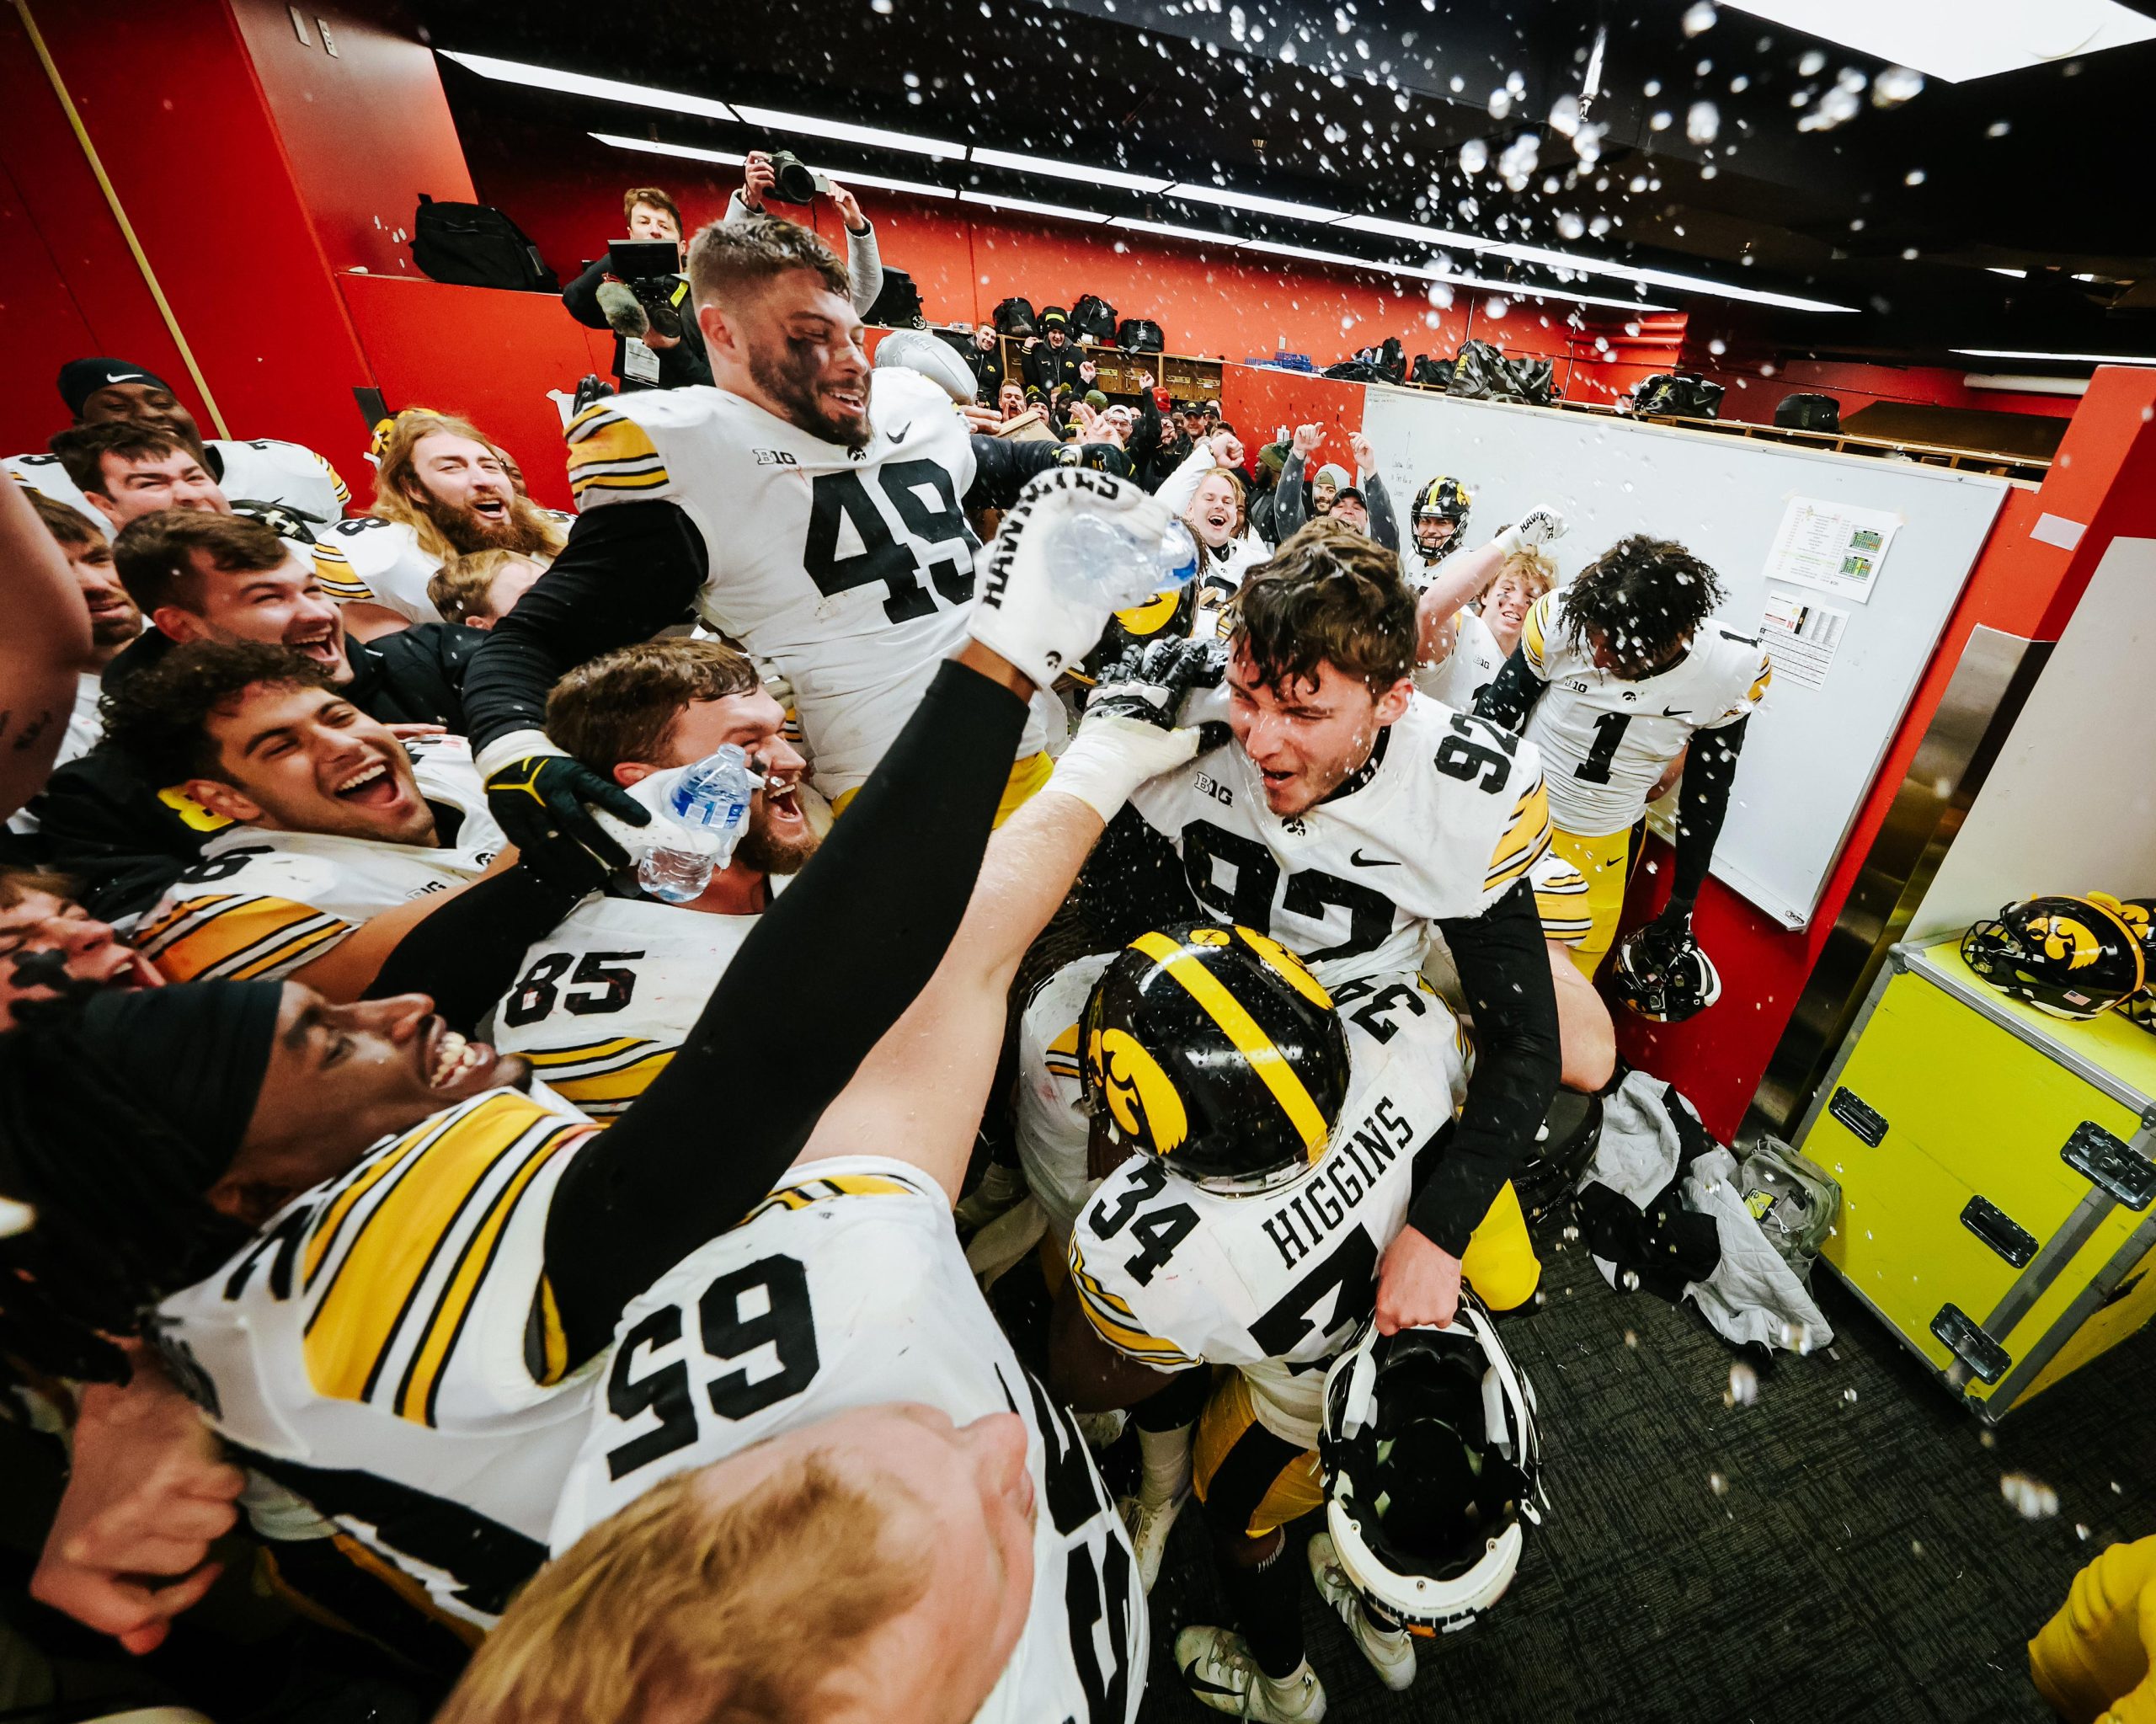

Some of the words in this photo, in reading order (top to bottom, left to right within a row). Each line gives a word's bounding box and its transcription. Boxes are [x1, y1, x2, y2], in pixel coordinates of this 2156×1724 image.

[803, 458, 984, 625] 49
[1434, 713, 1521, 795] 92
[1573, 712, 1632, 785] 1
[1181, 818, 1398, 965] 92
[504, 950, 645, 1028] 85
[1088, 1161, 1201, 1287] 34
[1262, 1096, 1415, 1270] HIGGINS
[606, 1252, 820, 1482] 65
